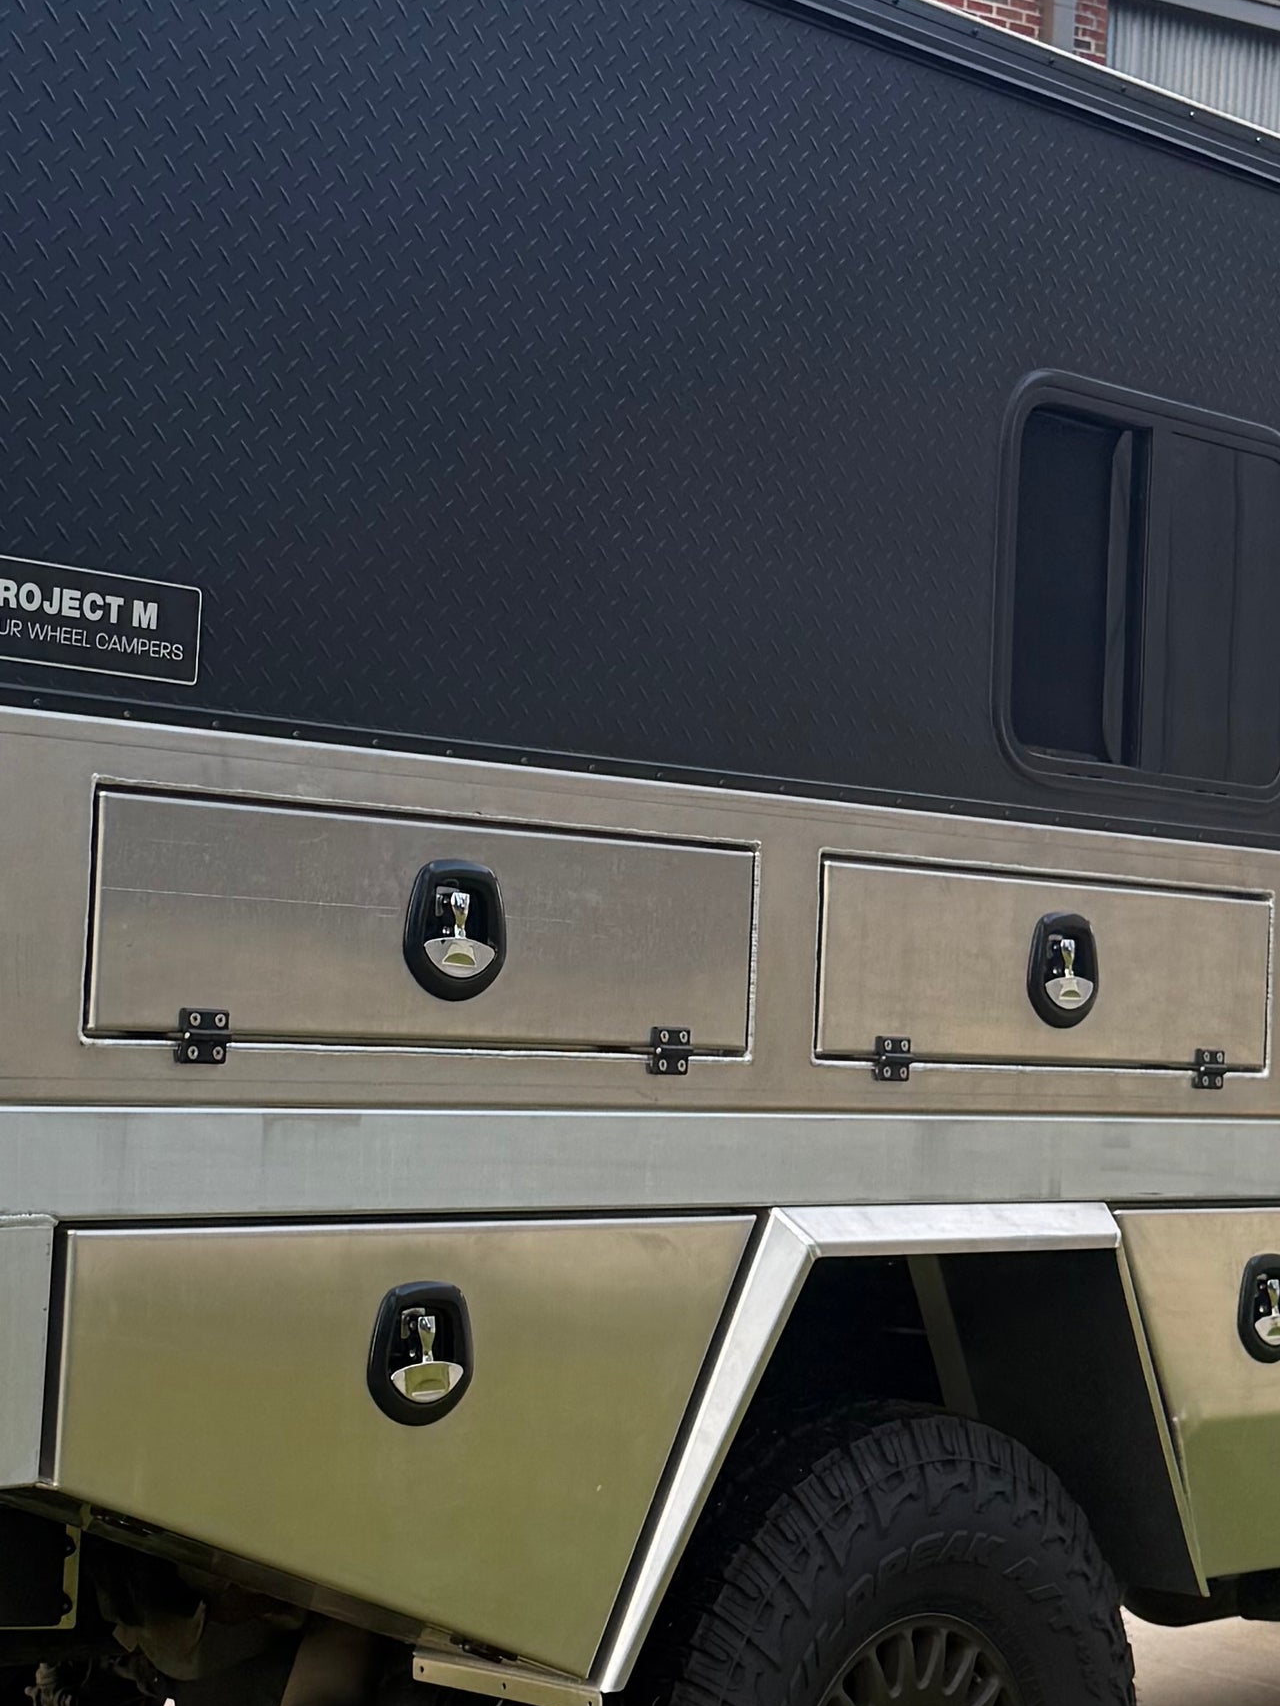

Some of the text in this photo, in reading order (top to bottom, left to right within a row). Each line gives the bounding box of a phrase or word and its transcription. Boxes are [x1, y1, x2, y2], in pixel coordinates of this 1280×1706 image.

[132, 599, 158, 630] M
[27, 621, 92, 649] WHEEL
[95, 632, 184, 661] CAMPERS
